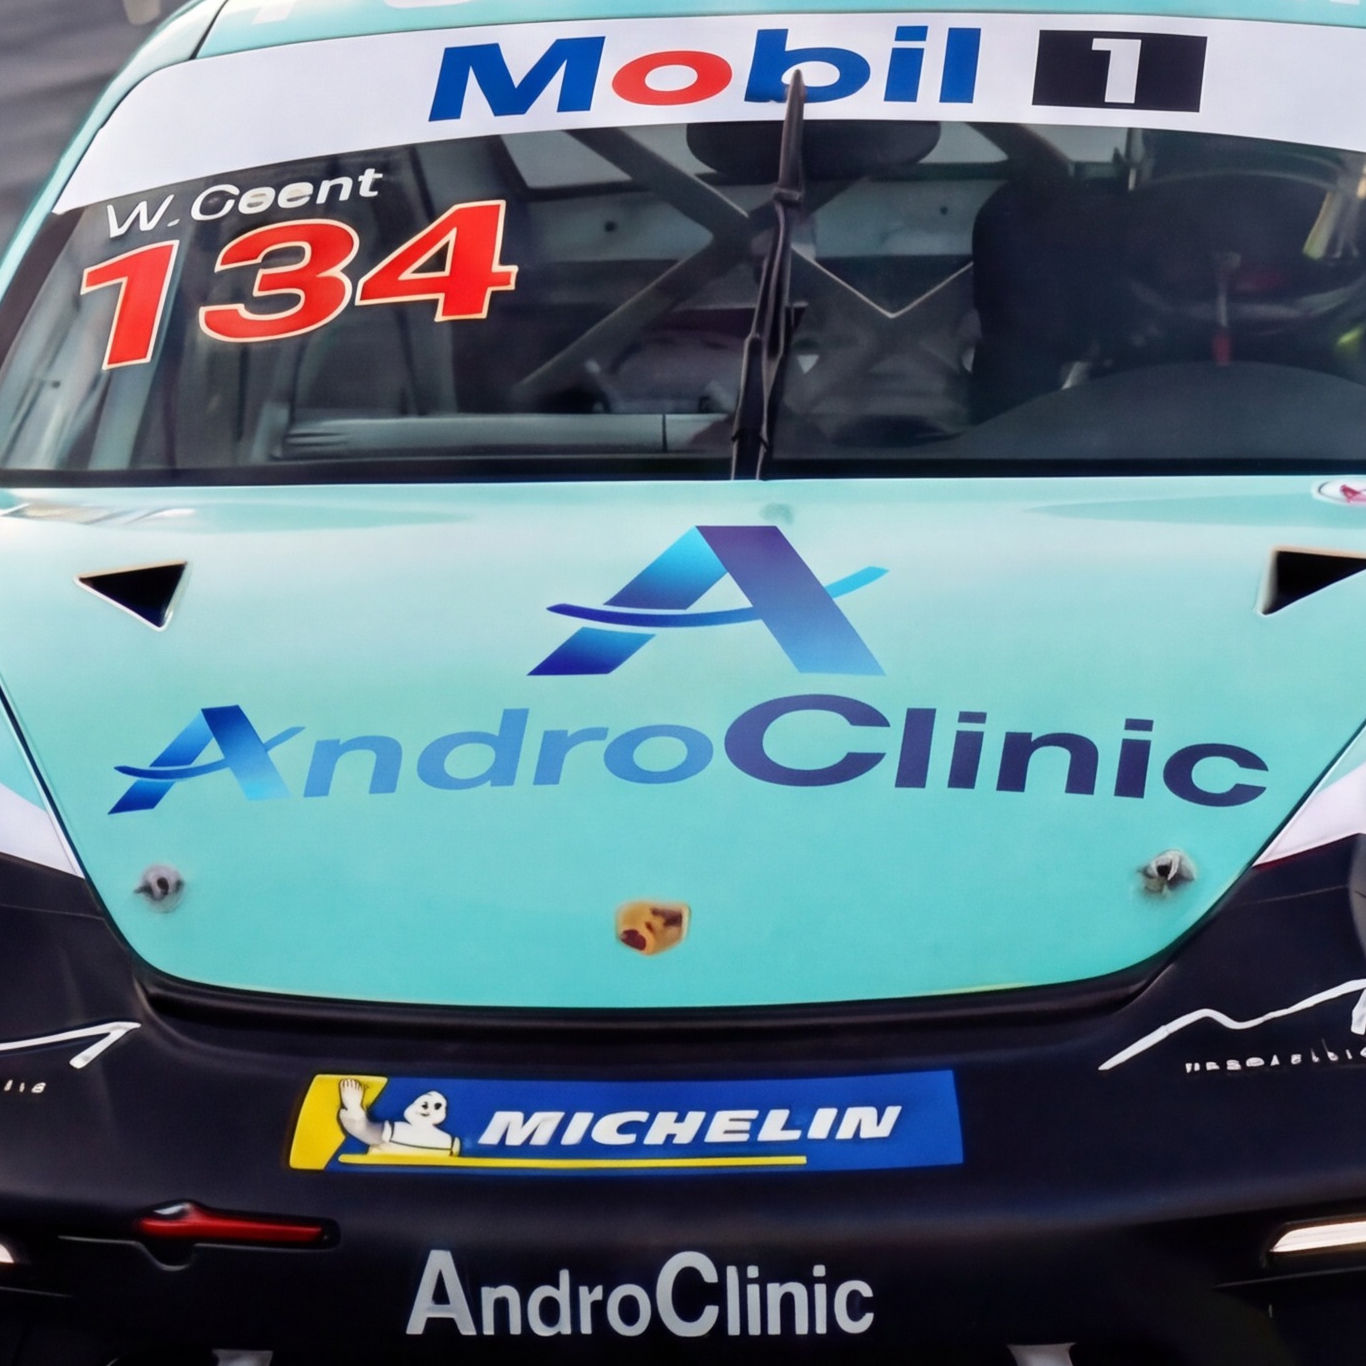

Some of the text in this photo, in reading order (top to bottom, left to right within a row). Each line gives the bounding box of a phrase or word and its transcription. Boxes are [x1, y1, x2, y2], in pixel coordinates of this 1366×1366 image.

[428, 25, 1143, 123] Mobil 1
[80, 199, 519, 371] 134
[107, 692, 1270, 816] AndroClinic
[477, 1104, 902, 1147] MICHELIN
[405, 1248, 875, 1338] AndroClinic
